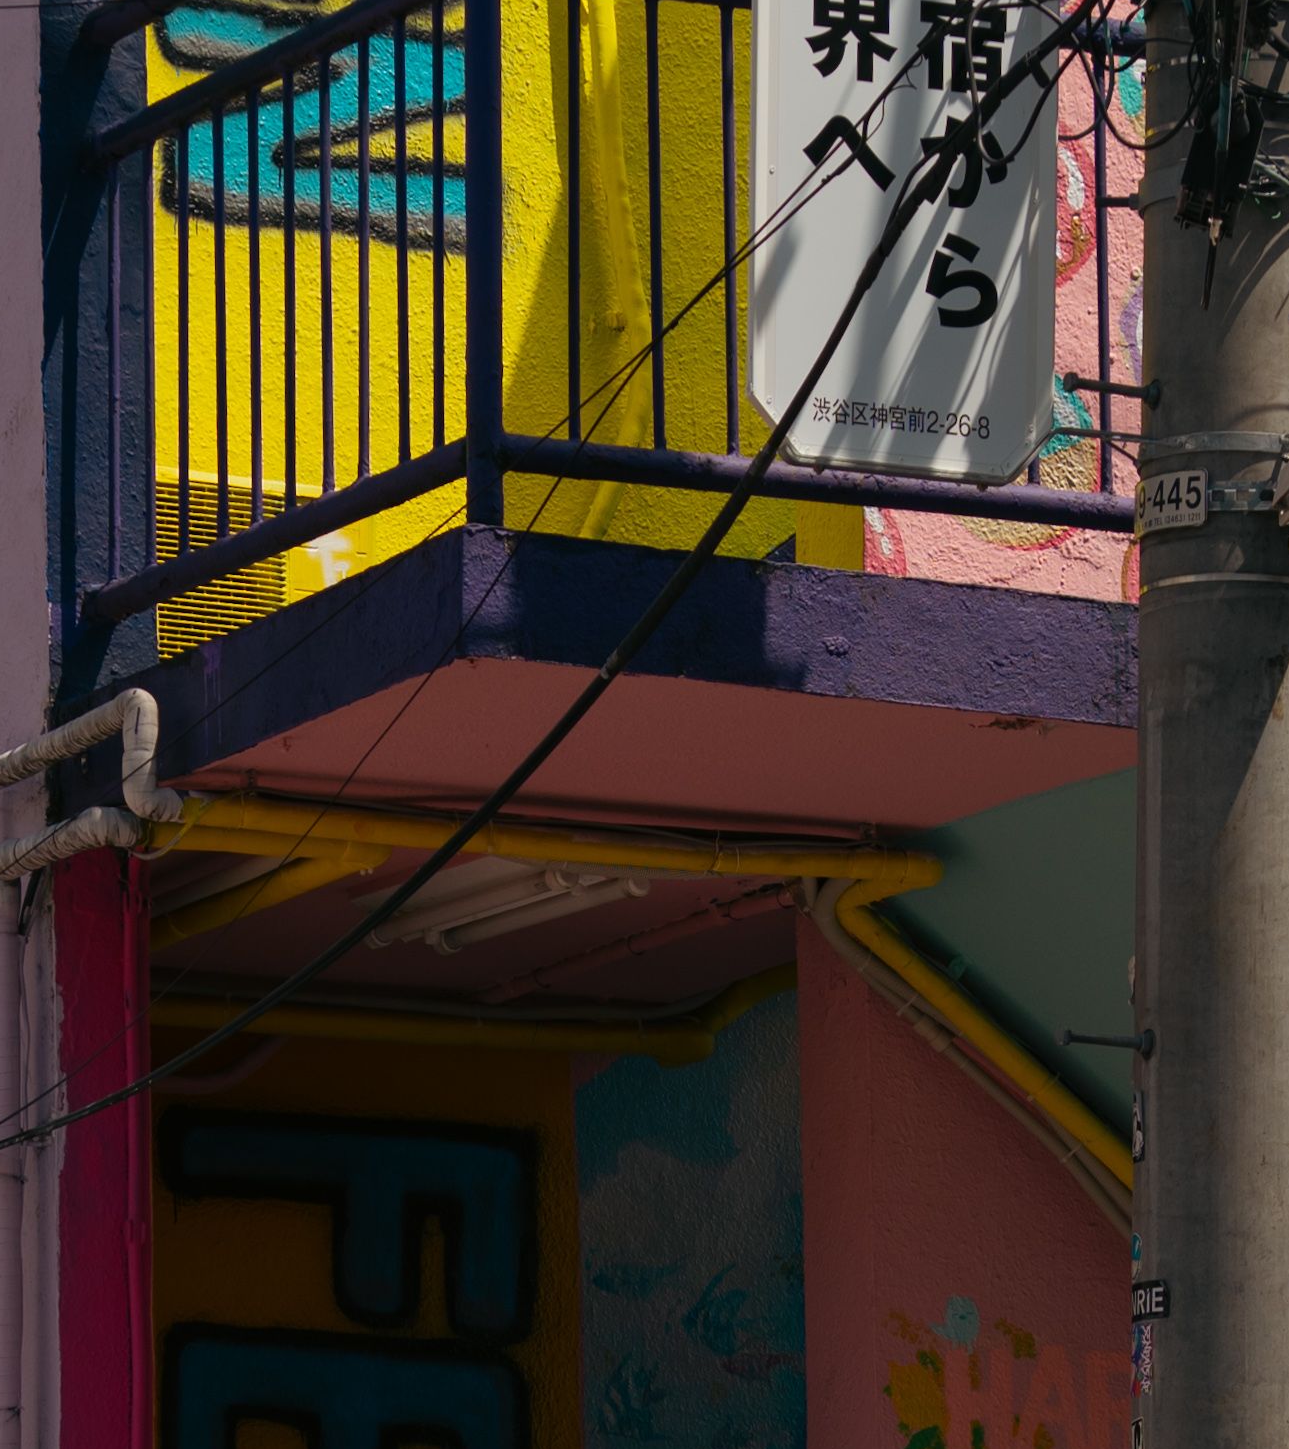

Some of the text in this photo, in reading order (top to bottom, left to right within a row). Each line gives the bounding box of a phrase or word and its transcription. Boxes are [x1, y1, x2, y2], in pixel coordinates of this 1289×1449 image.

[810, 395, 992, 445] 渋谷区神宮前2-26-8
